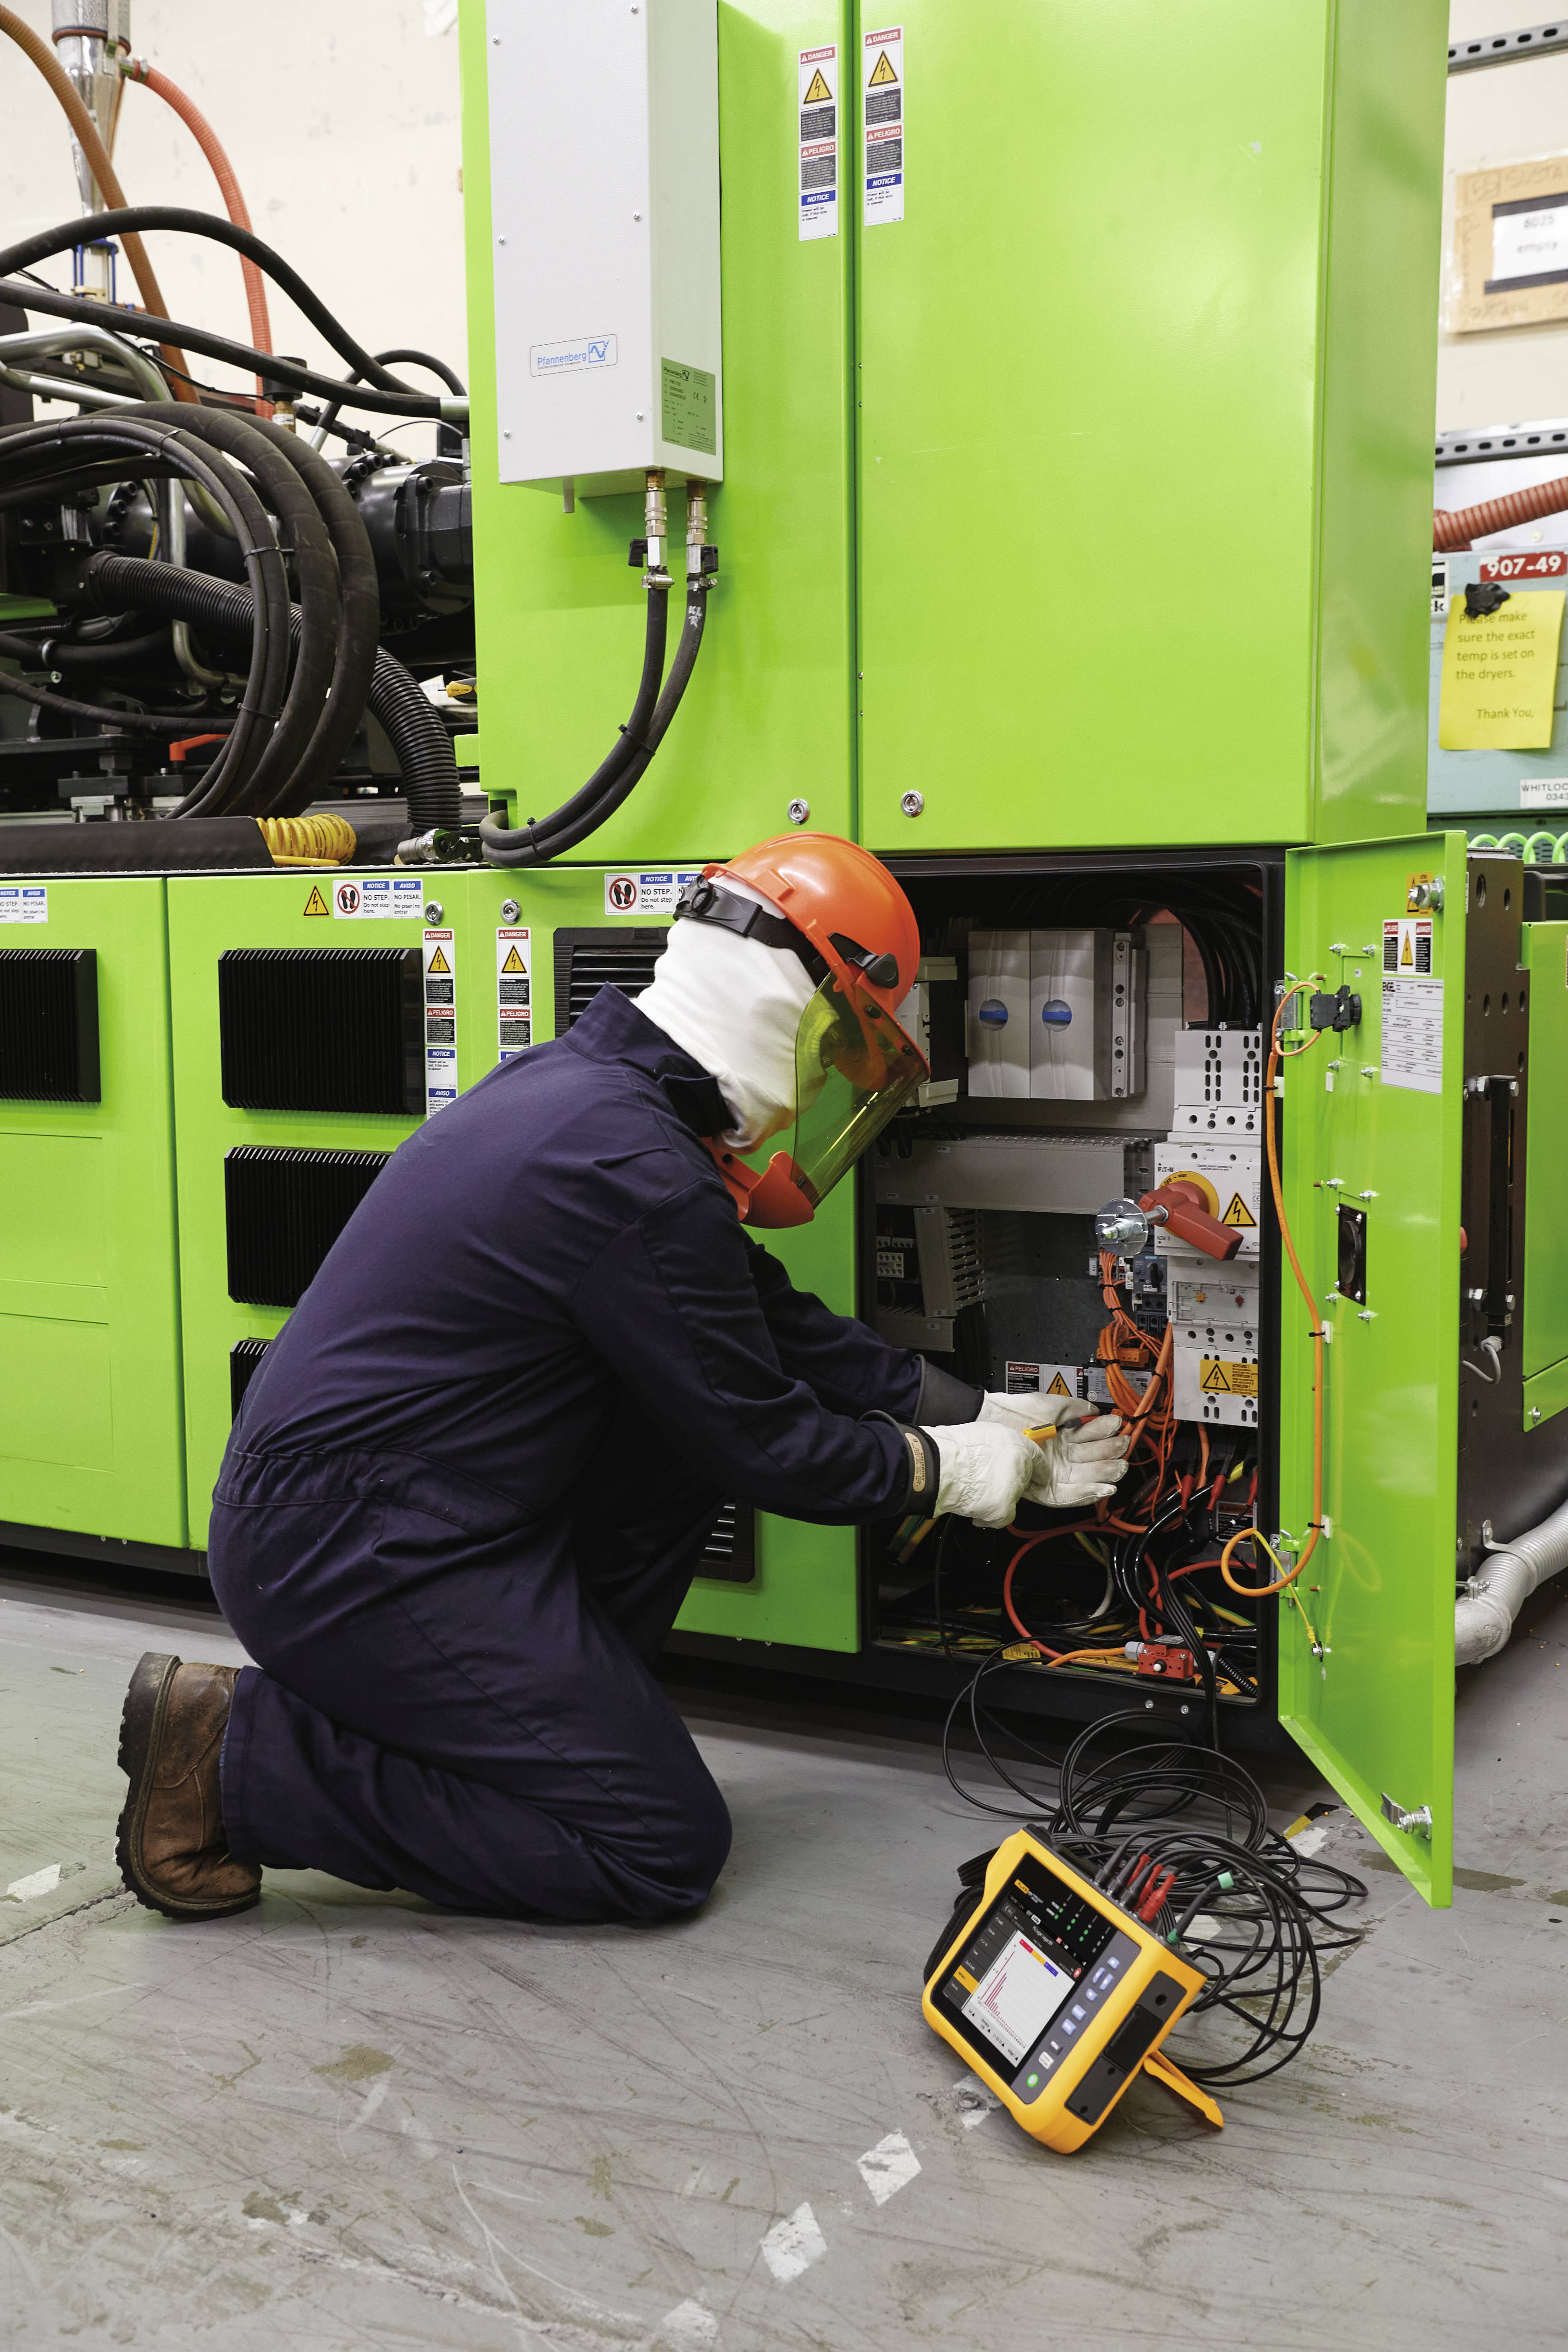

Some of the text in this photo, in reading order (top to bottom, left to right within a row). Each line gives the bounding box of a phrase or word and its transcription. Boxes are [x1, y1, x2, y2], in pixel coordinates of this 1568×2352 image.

[873, 32, 898, 42] DANGER
[807, 50, 833, 60] DANGER
[874, 128, 900, 138] PELIGRO
[808, 145, 834, 155] PELIGRO
[872, 177, 896, 186] NOTICE
[807, 194, 830, 203] NOTICE
[538, 352, 586, 366] Pfannenberg
[1487, 555, 1562, 577] 907-49
[1499, 611, 1528, 622] make
[1457, 630, 1535, 643] sure the exact
[1457, 650, 1534, 662] temp is set on
[1456, 669, 1515, 681] the dryers.
[1477, 709, 1510, 719] Thank
[1383, 982, 1395, 992] ENGEL
[1164, 1178, 1173, 1186] OFF
